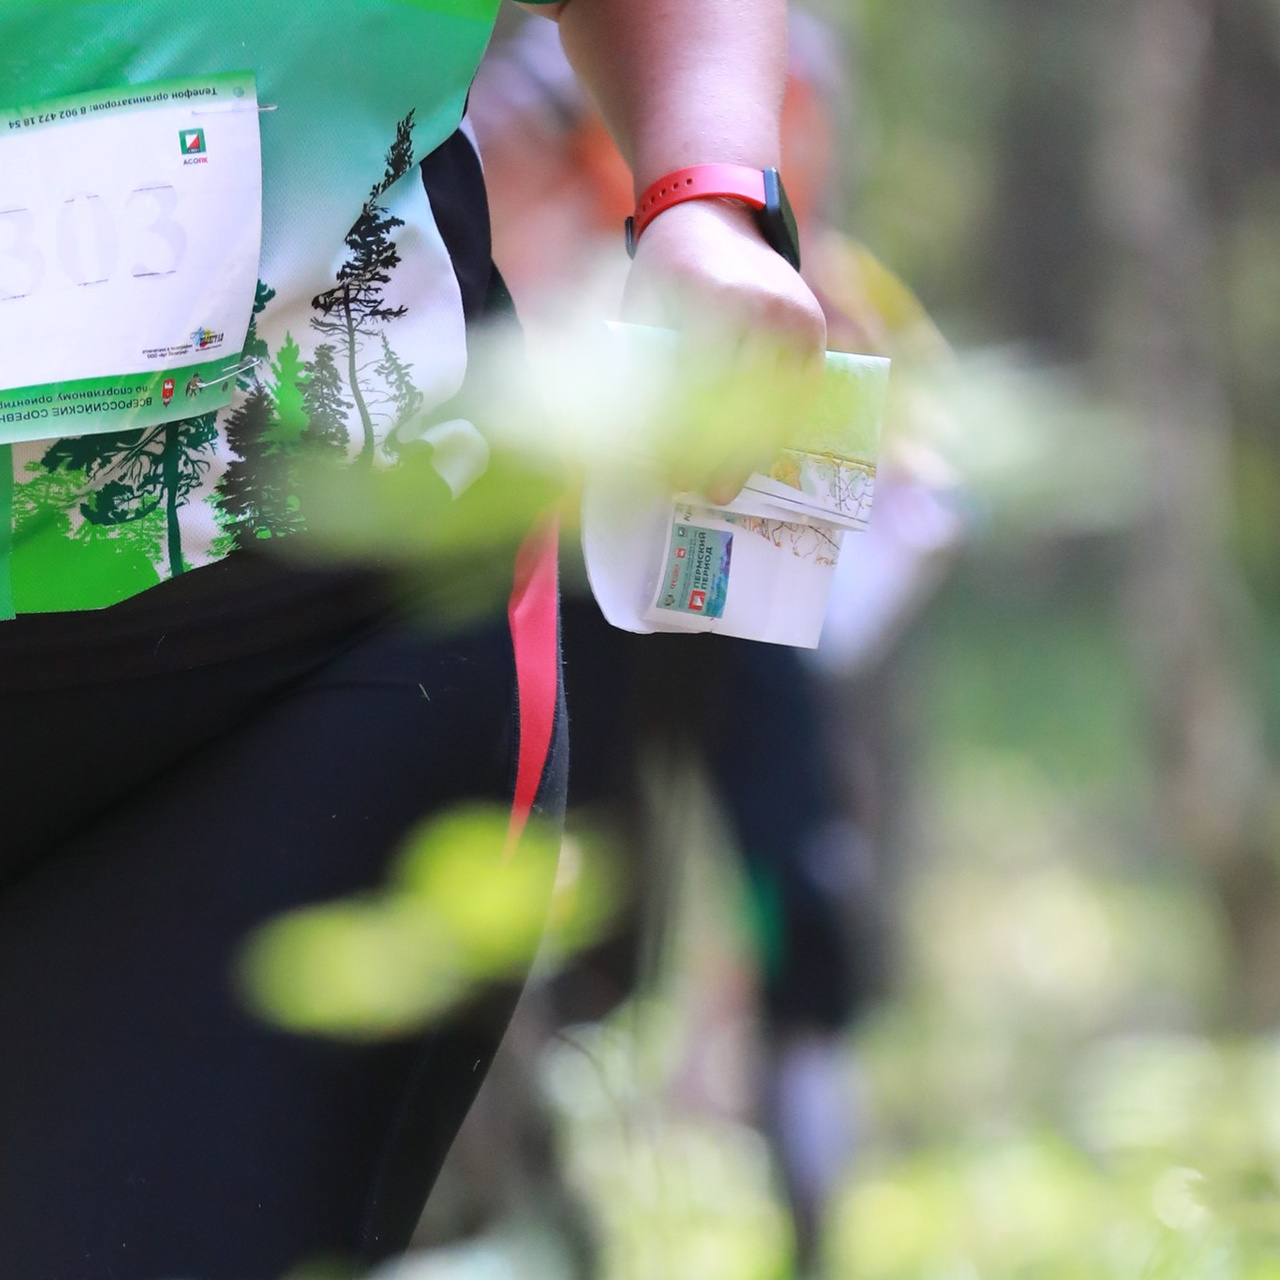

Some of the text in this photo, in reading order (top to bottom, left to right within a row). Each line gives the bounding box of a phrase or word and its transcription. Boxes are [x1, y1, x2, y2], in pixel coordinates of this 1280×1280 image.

[8, 87, 218, 130] Телефон организаторов: 8 902 472 18 54
[57, 387, 133, 402] спортивному
[135, 385, 148, 393] по
[52, 396, 153, 417] ВСЕРОССИЙСКИЕ
[693, 531, 707, 589] ПЕРМСКИЙ
[701, 546, 713, 590] ПЕРИОД
